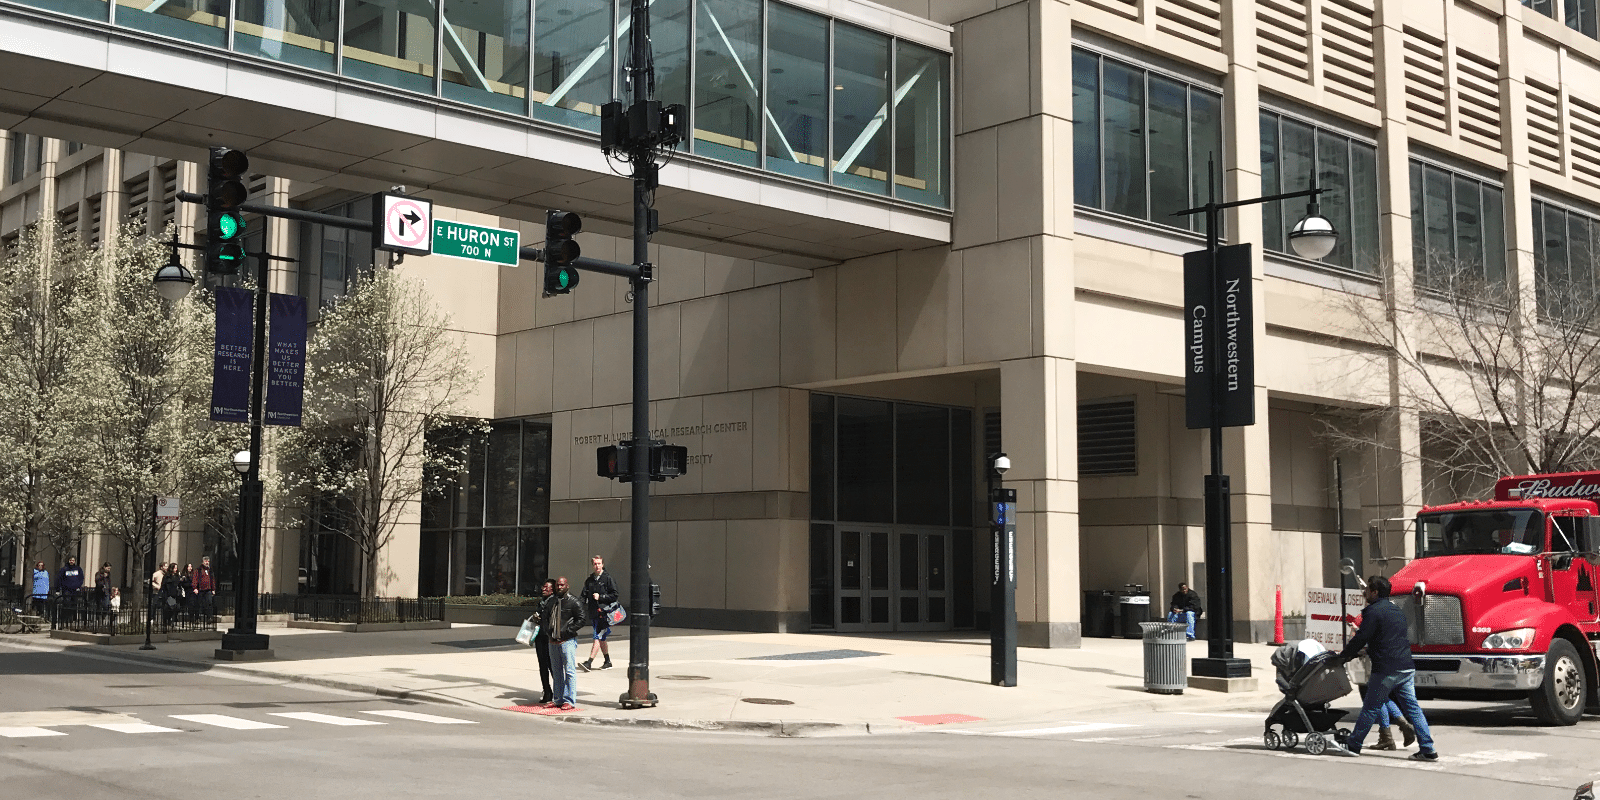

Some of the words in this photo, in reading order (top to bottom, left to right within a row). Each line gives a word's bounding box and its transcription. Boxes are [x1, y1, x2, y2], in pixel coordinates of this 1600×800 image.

[436, 226, 443, 236] E
[447, 225, 500, 247] HURON
[503, 237, 515, 247] ST
[461, 244, 480, 256] 700
[484, 248, 492, 258] N
[1190, 305, 1207, 373] Campus
[1226, 278, 1241, 391] Northwestern
[217, 350, 250, 359] RESEARCH
[220, 344, 247, 352] BETTER
[272, 360, 300, 368] BETTER
[271, 380, 300, 388] BETTER.
[574, 434, 602, 445] ROBERT
[603, 434, 611, 442] H.
[671, 424, 712, 437] RESEARCH
[714, 422, 747, 433] CENTER
[686, 454, 713, 465] ERSITY
[1518, 479, 1600, 499] Budw
[1307, 591, 1337, 604] SIDEWALK
